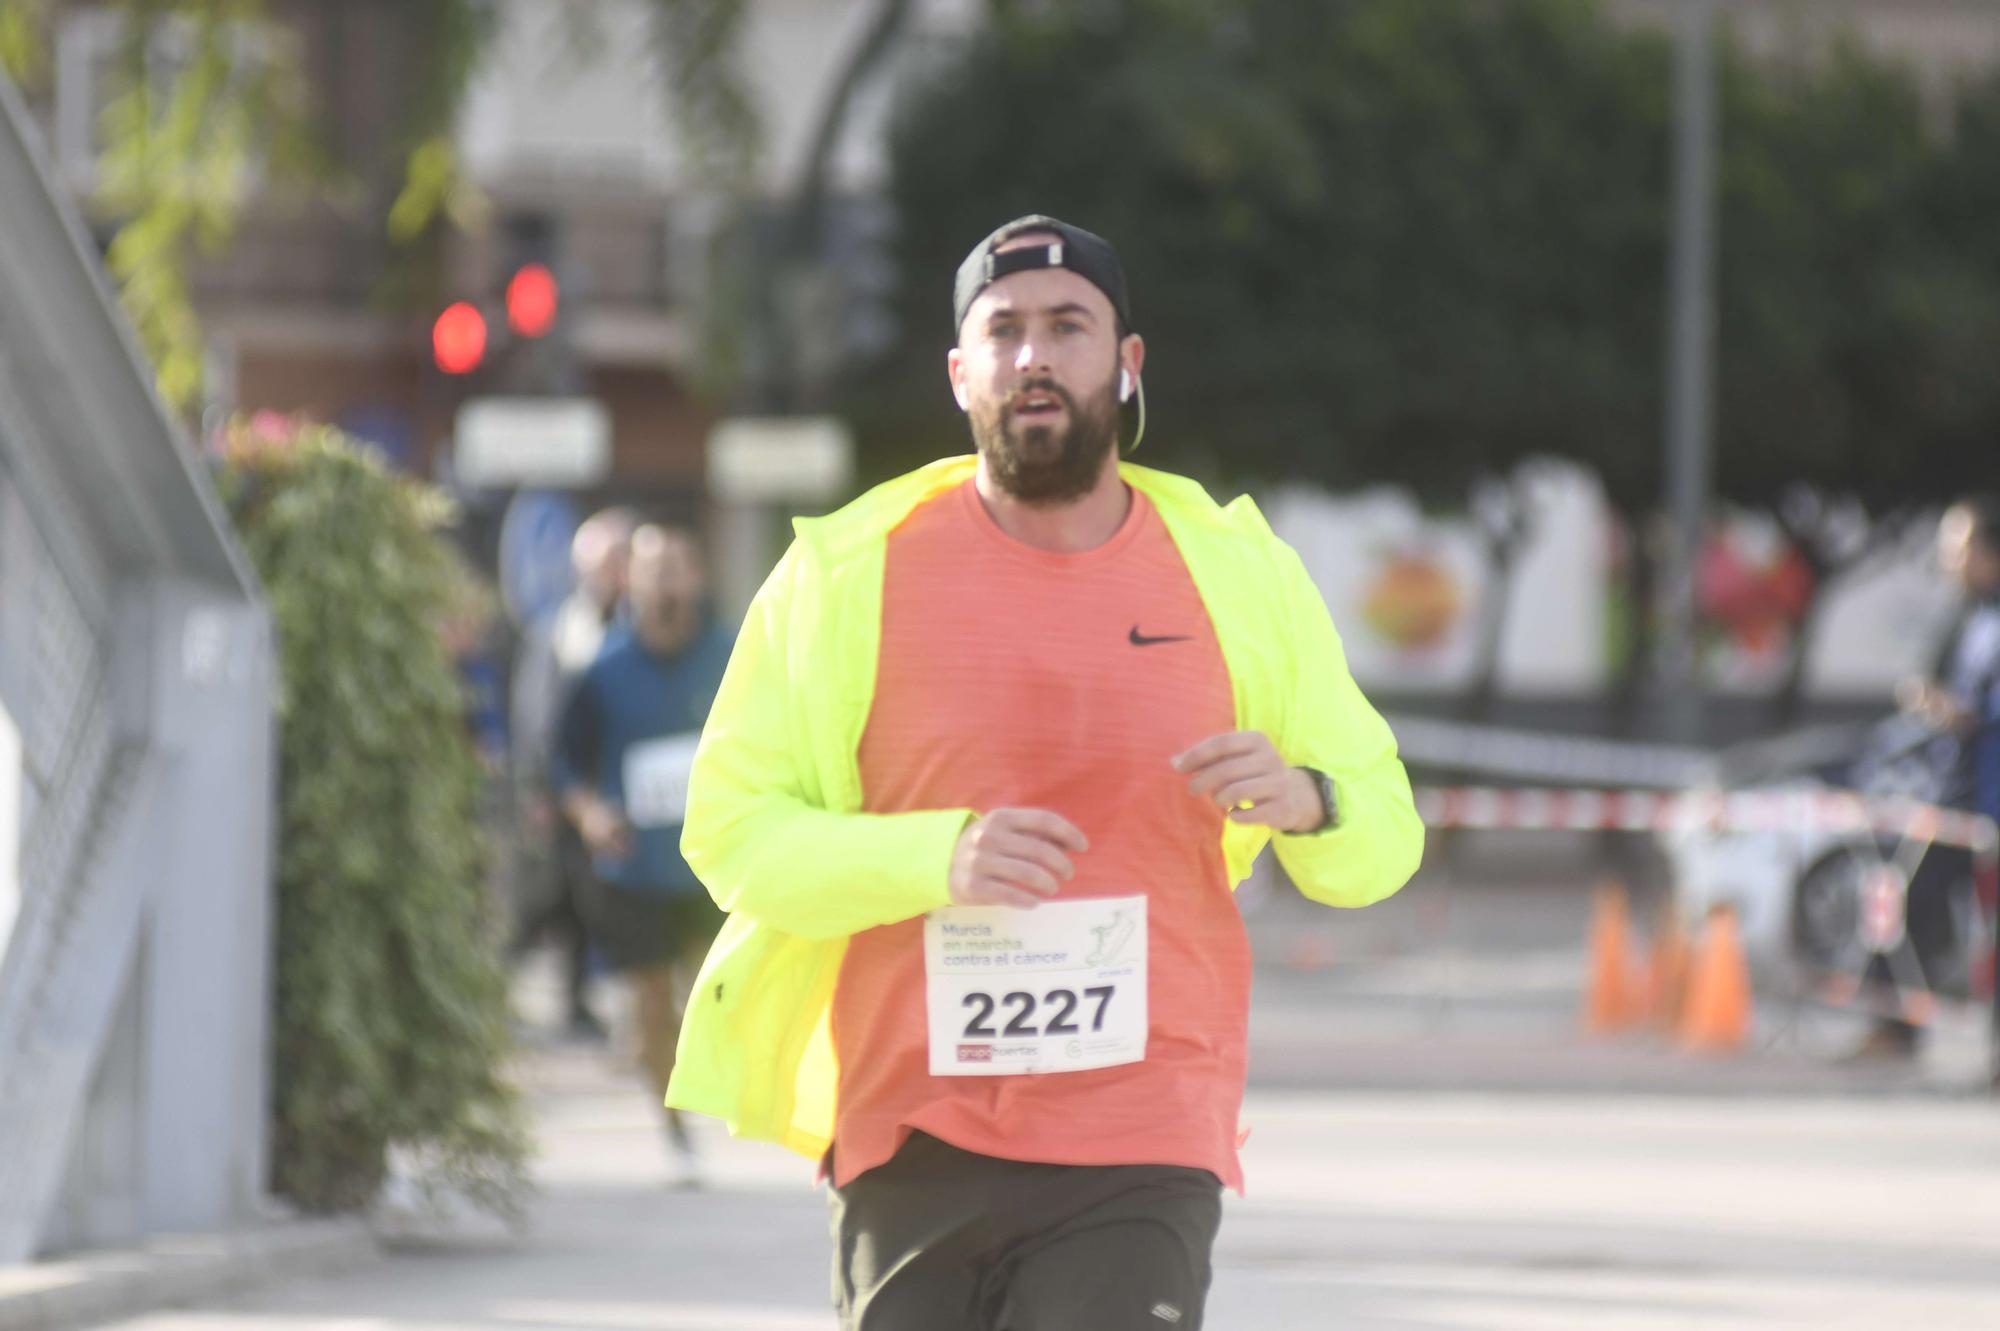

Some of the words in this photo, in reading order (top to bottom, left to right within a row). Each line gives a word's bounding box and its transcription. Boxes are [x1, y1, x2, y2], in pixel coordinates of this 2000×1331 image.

[942, 924, 992, 936] Murcia
[943, 941, 961, 950] en
[965, 938, 1024, 950] marcha
[943, 953, 991, 966] contra
[994, 952, 1009, 965] el
[961, 985, 1115, 1038] 2227
